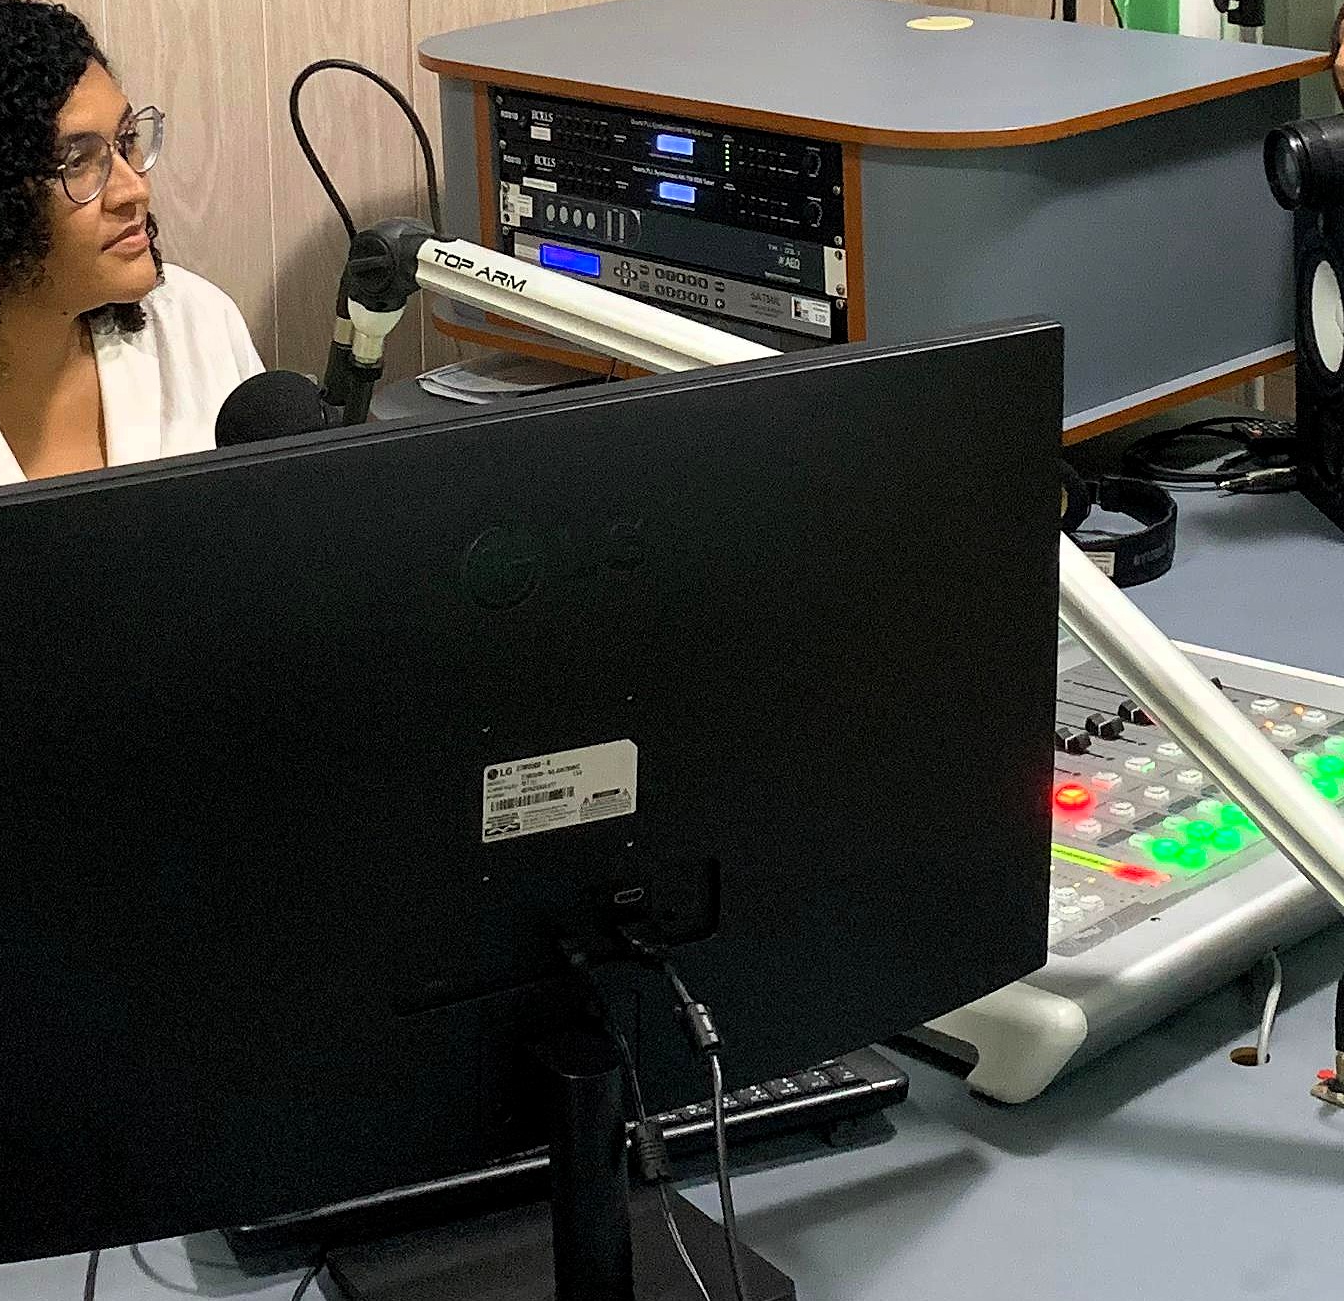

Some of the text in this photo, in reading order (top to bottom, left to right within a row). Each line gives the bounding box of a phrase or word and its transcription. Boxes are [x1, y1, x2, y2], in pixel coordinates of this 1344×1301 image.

[434, 248, 527, 292] TOP ARM
[499, 767, 513, 777] LG
